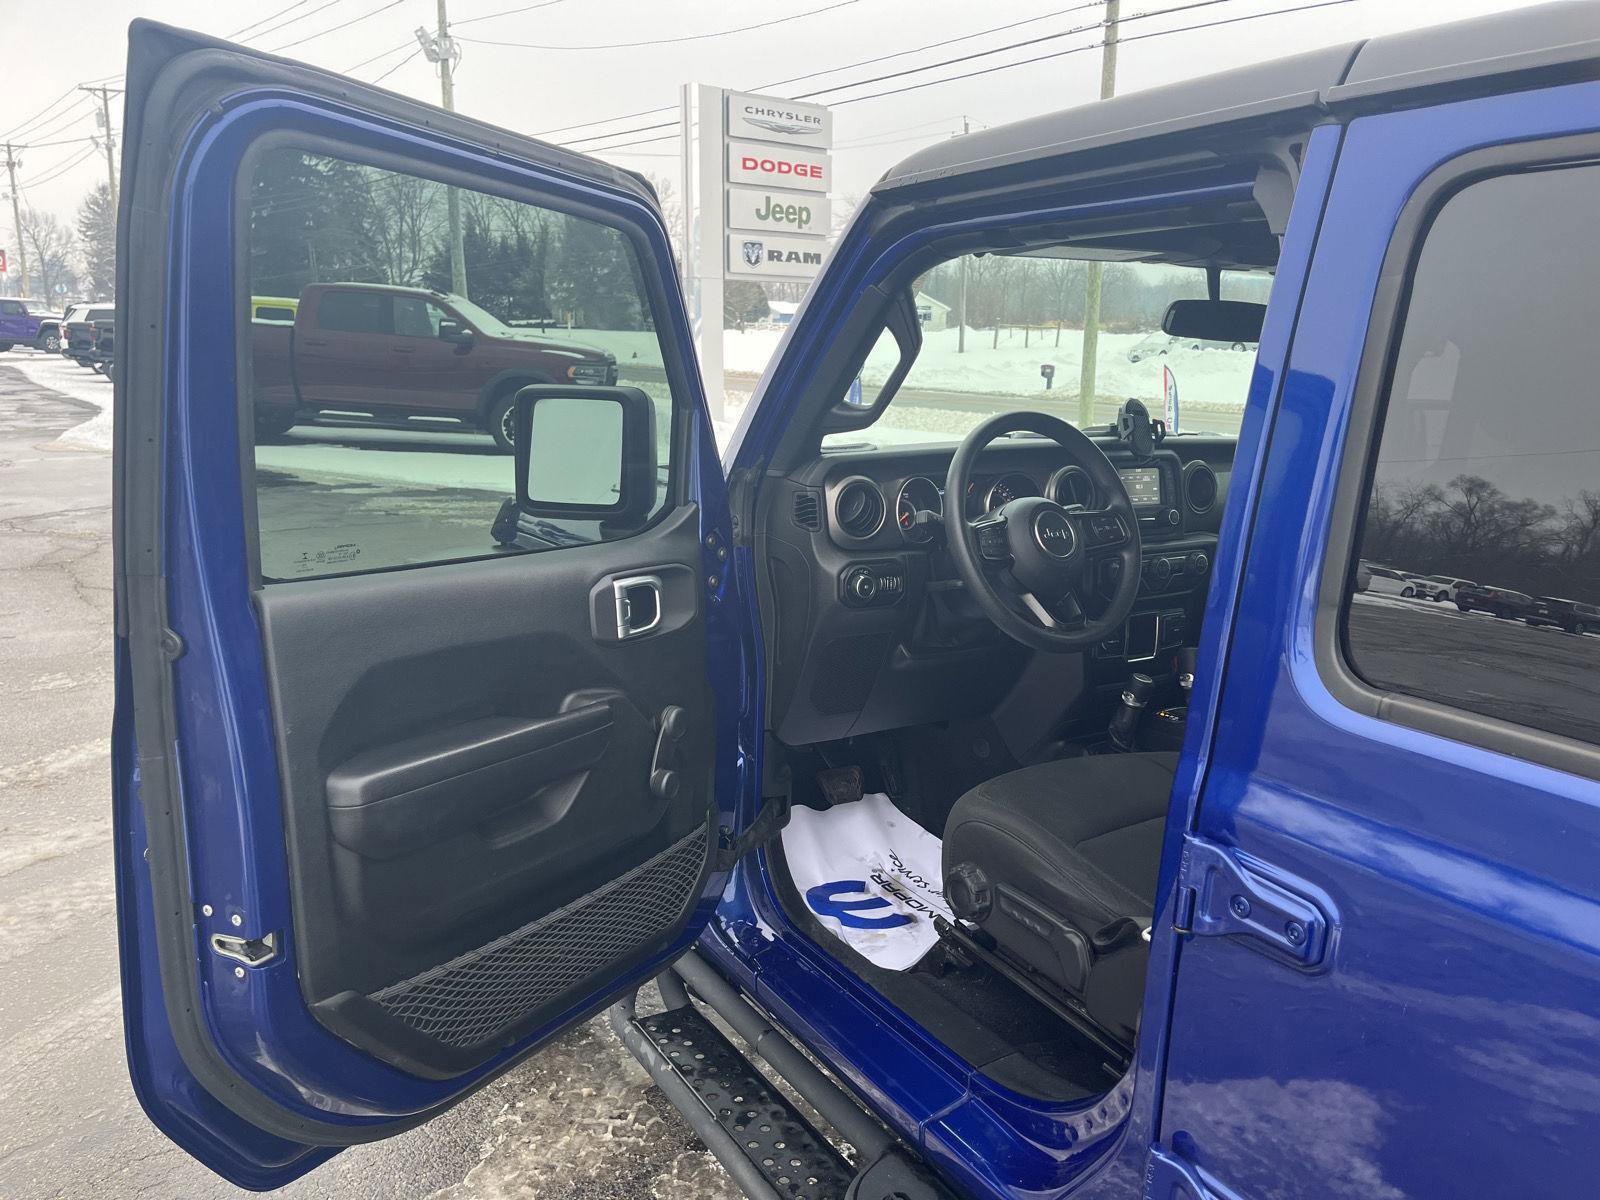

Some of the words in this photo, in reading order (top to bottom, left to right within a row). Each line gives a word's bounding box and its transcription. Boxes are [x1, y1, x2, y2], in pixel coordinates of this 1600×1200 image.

[744, 105, 823, 126] CHRYSLER
[741, 156, 823, 179] DODGE
[755, 195, 812, 230] Jeep
[767, 249, 822, 265] RAM
[889, 848, 930, 889] service
[870, 873, 940, 919] MOPAR
